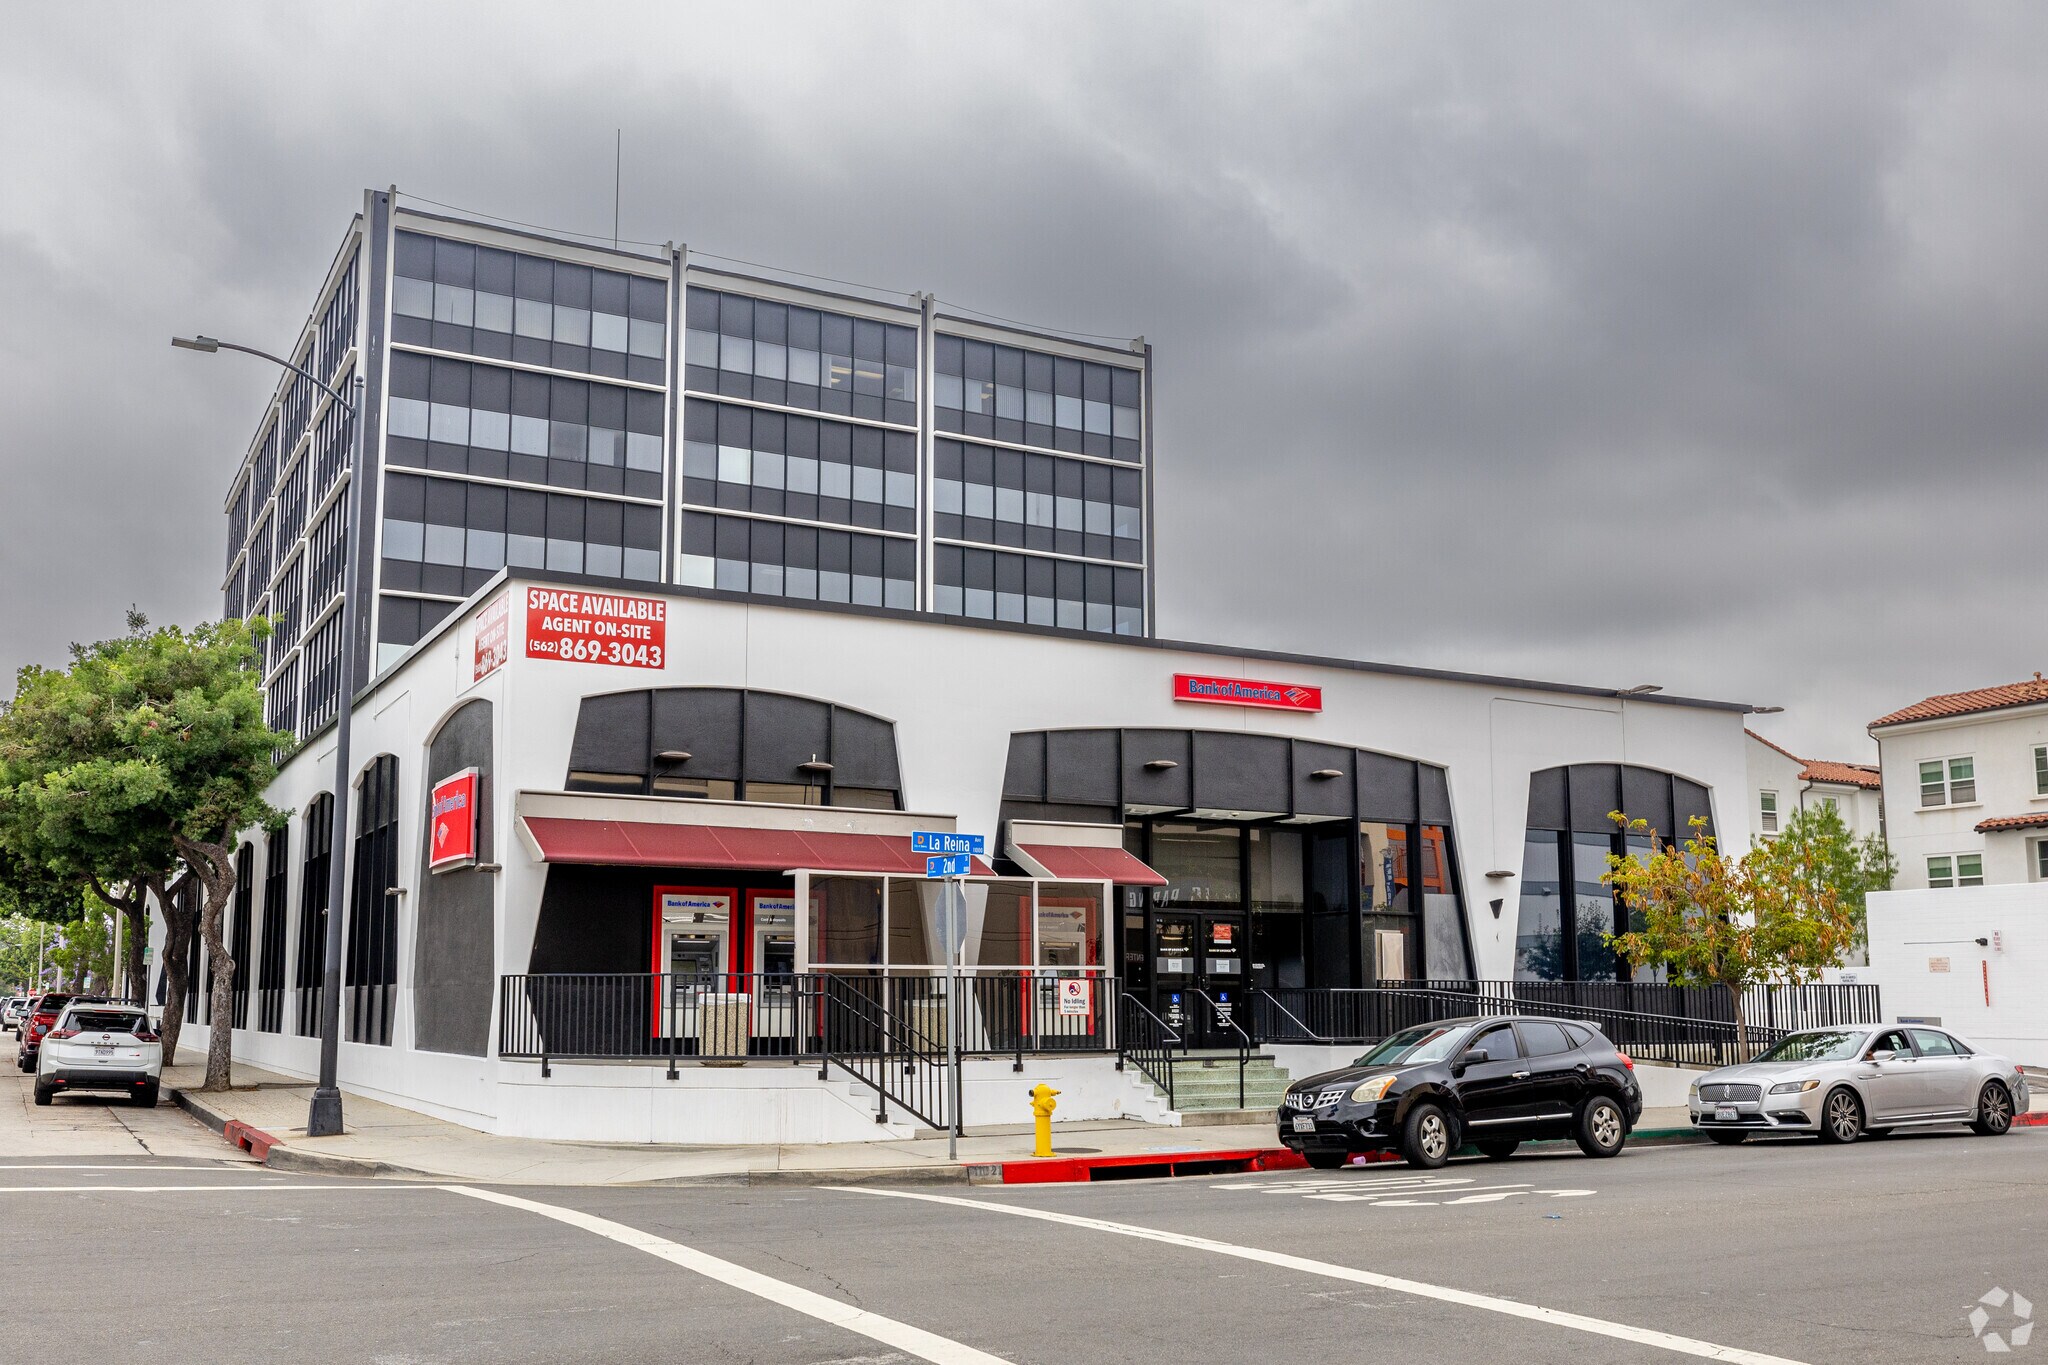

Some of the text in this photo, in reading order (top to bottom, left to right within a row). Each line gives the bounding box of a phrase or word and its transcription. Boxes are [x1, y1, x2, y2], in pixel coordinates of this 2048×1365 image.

[529, 590, 664, 622] SPACE AVAILABLE
[542, 616, 651, 640] AGENT ON-SITE
[529, 638, 661, 667] (562) 869-3043
[1189, 679, 1281, 701] Bank of America
[929, 834, 970, 852] La Reina
[942, 857, 956, 874] 2nd
